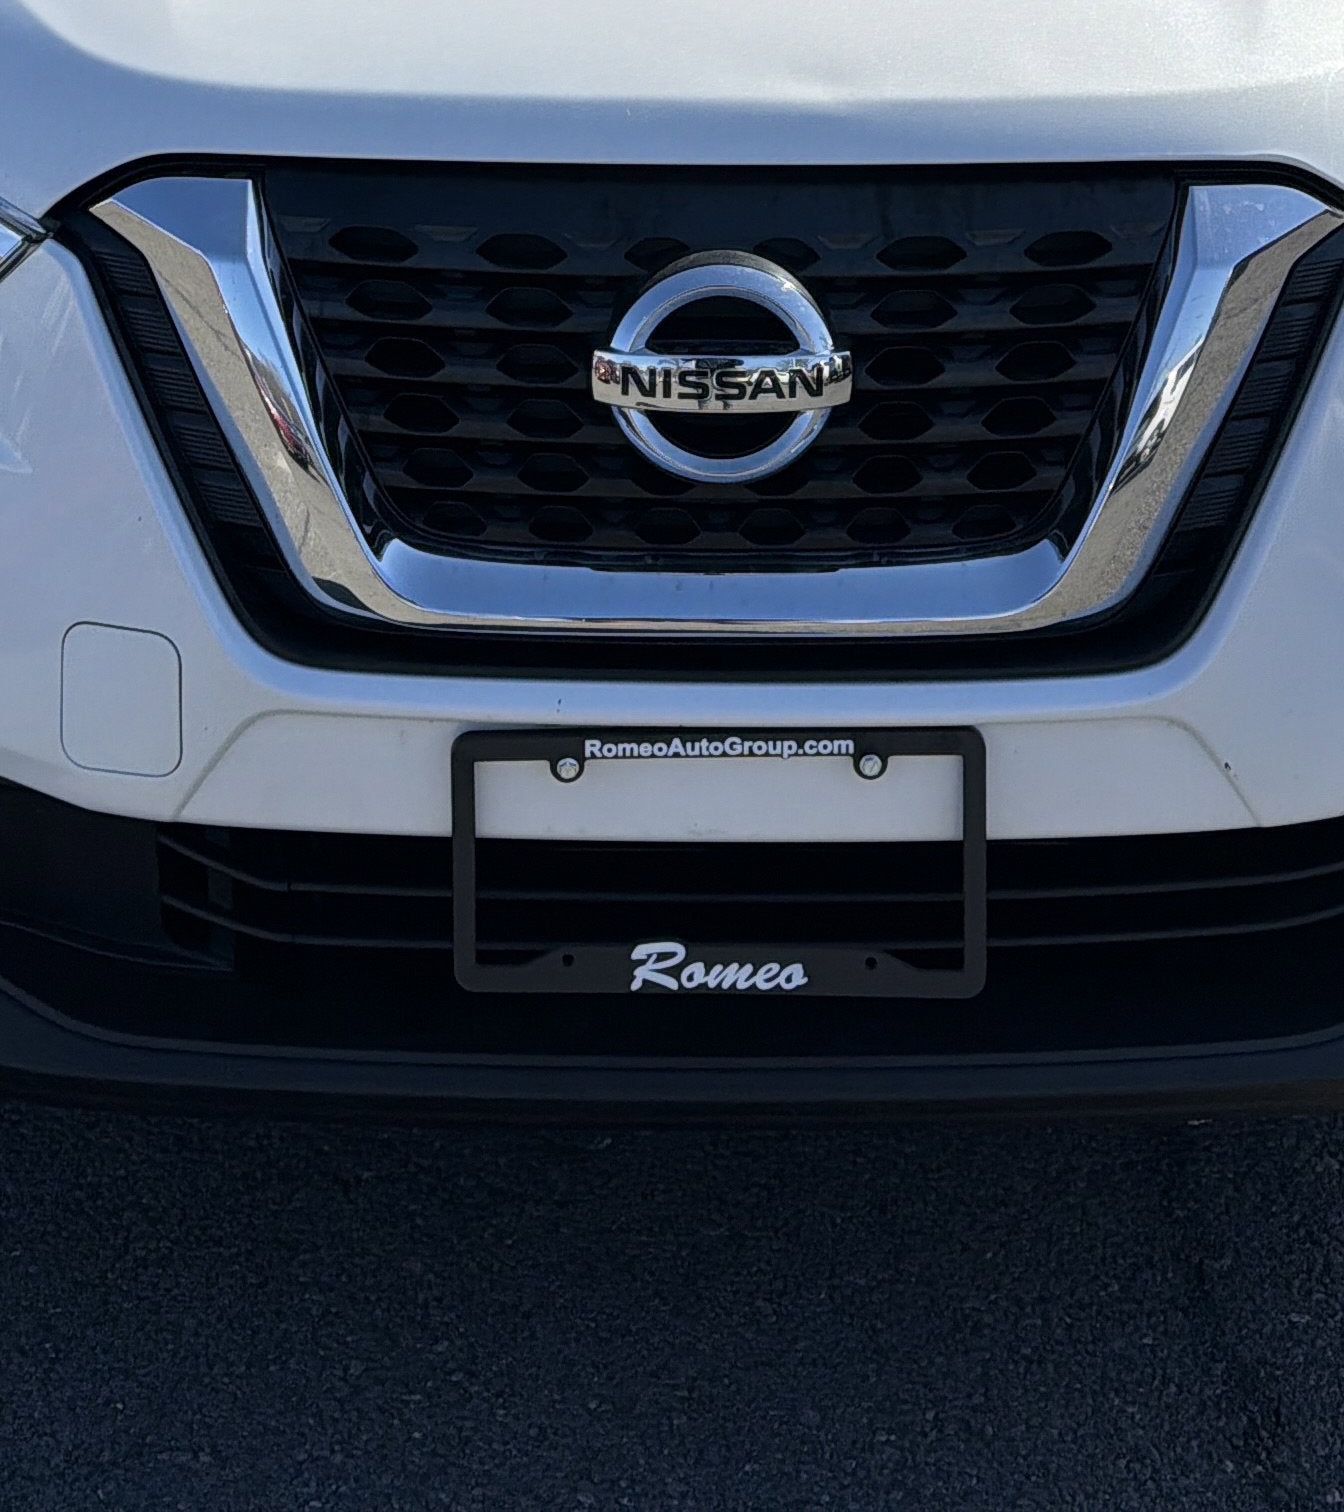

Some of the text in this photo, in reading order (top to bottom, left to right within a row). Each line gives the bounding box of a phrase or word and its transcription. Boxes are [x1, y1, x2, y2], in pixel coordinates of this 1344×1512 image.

[621, 366, 824, 400] NISSAN
[584, 736, 855, 759] RomeoAutoGroup.com
[630, 942, 809, 992] Romeo
